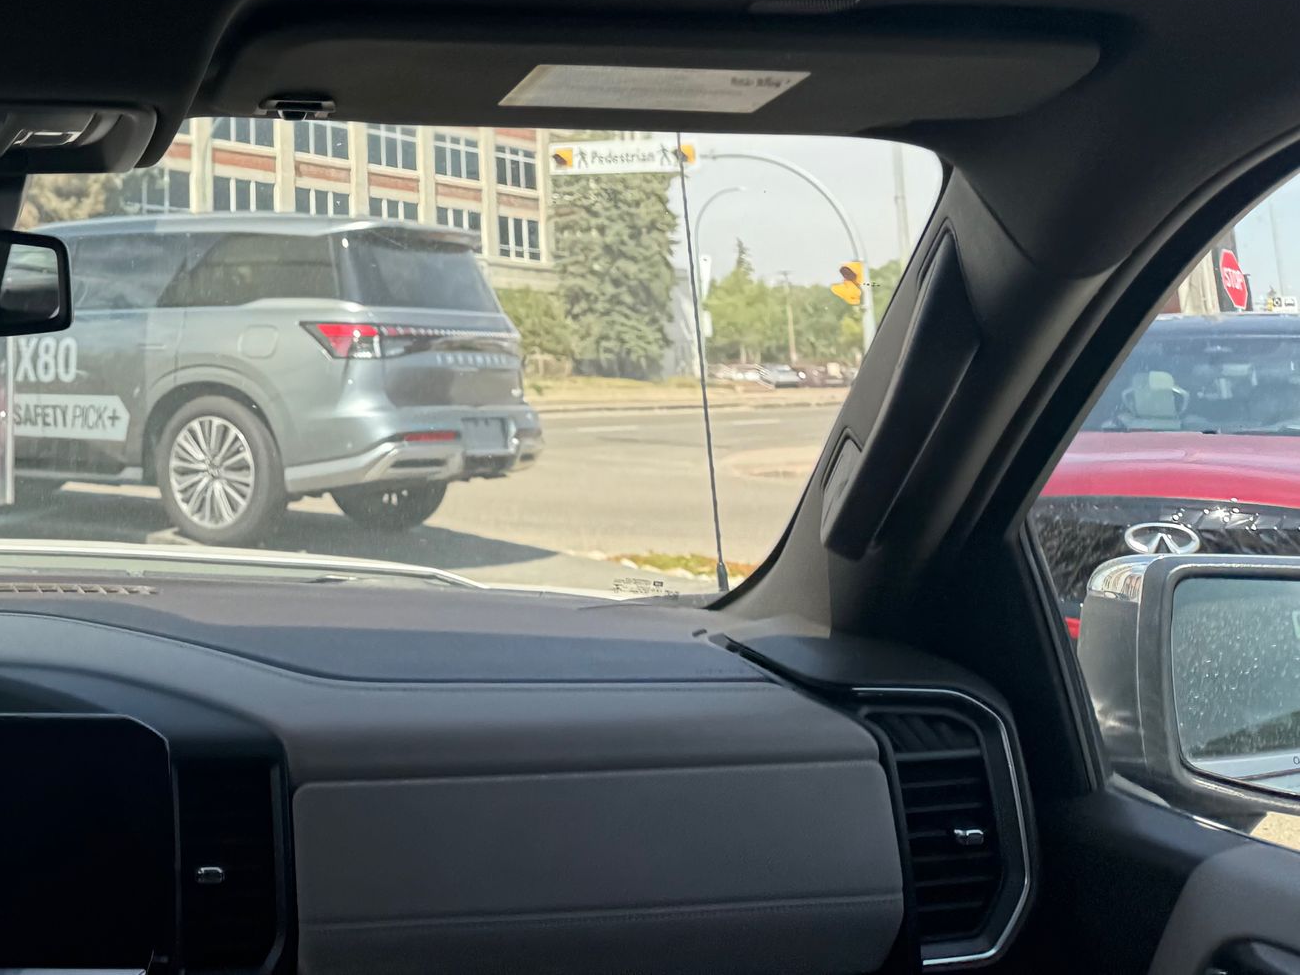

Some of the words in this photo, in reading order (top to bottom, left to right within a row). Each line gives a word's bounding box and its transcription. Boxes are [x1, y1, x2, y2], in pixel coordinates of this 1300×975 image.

[590, 149, 656, 166] Pedestrian
[1223, 267, 1244, 290] STOP
[15, 336, 78, 383] X80
[13, 403, 69, 428] SAFETY
